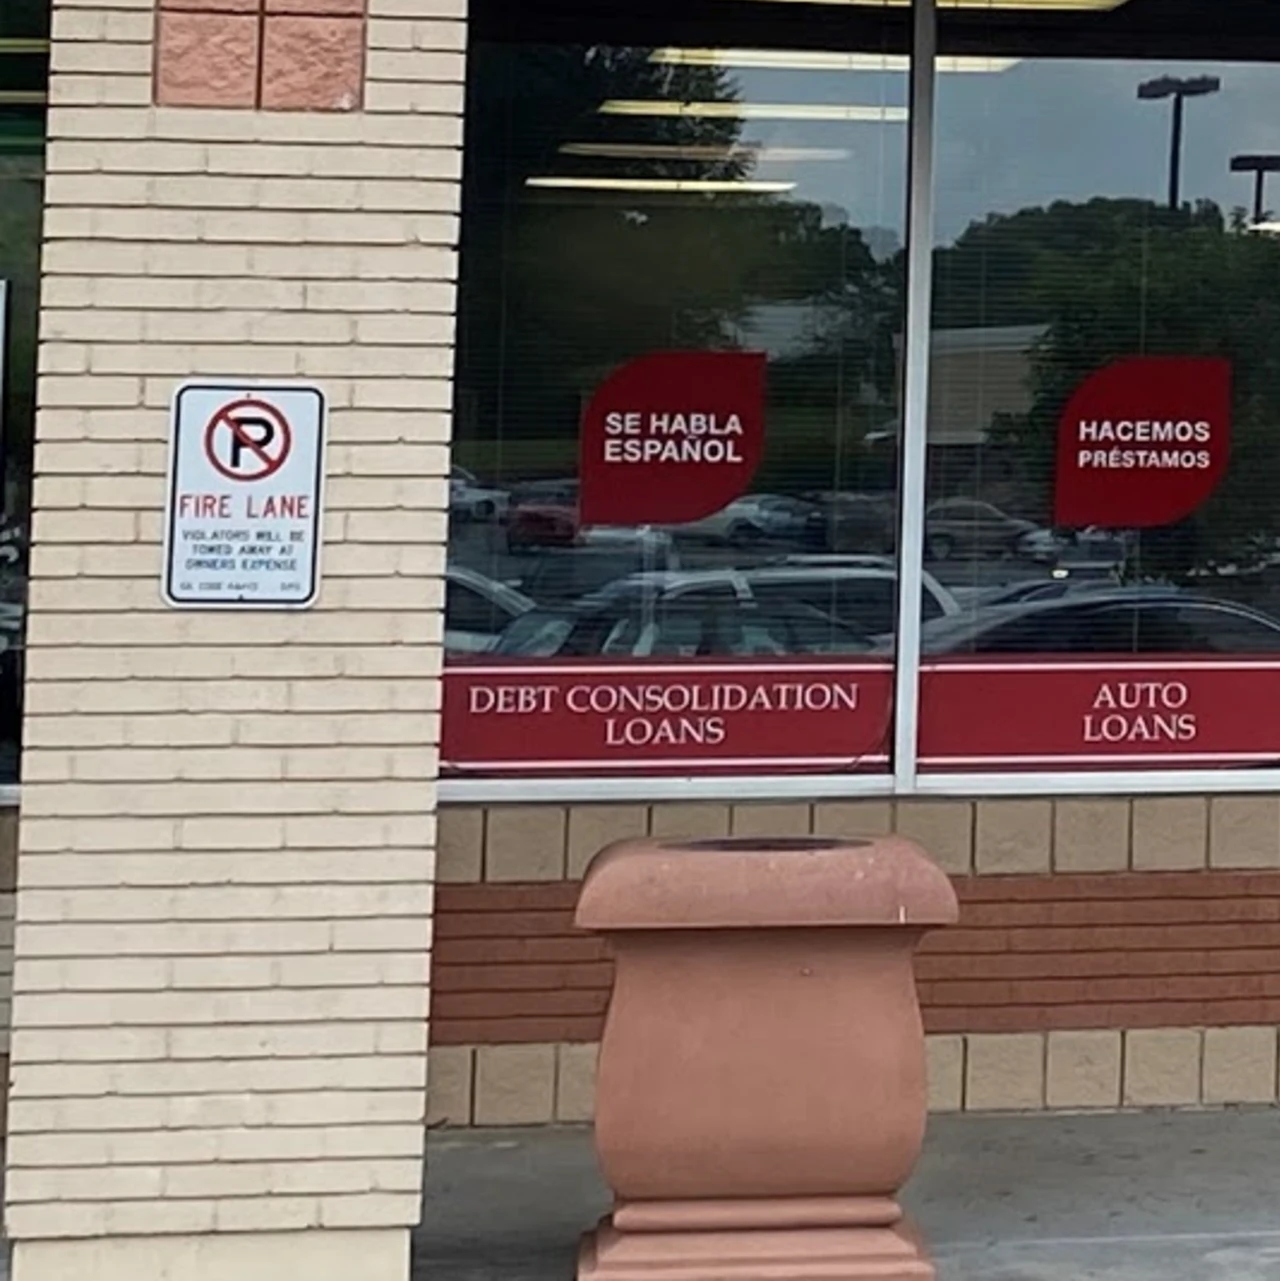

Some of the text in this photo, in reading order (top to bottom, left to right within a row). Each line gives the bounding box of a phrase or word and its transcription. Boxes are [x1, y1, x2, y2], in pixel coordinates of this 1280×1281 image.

[604, 412, 744, 435] SE HABLA
[1078, 420, 1211, 442] HACEMOS
[604, 435, 744, 463] ESPAÑOL
[1077, 446, 1211, 469] PRÉSTAMOS
[178, 494, 310, 519] FIRE LANE
[468, 682, 859, 714] DEBT CONSOLIDATION
[1092, 681, 1187, 710] AUTO
[604, 717, 726, 746] LOANS
[1082, 713, 1197, 742] LOANS
